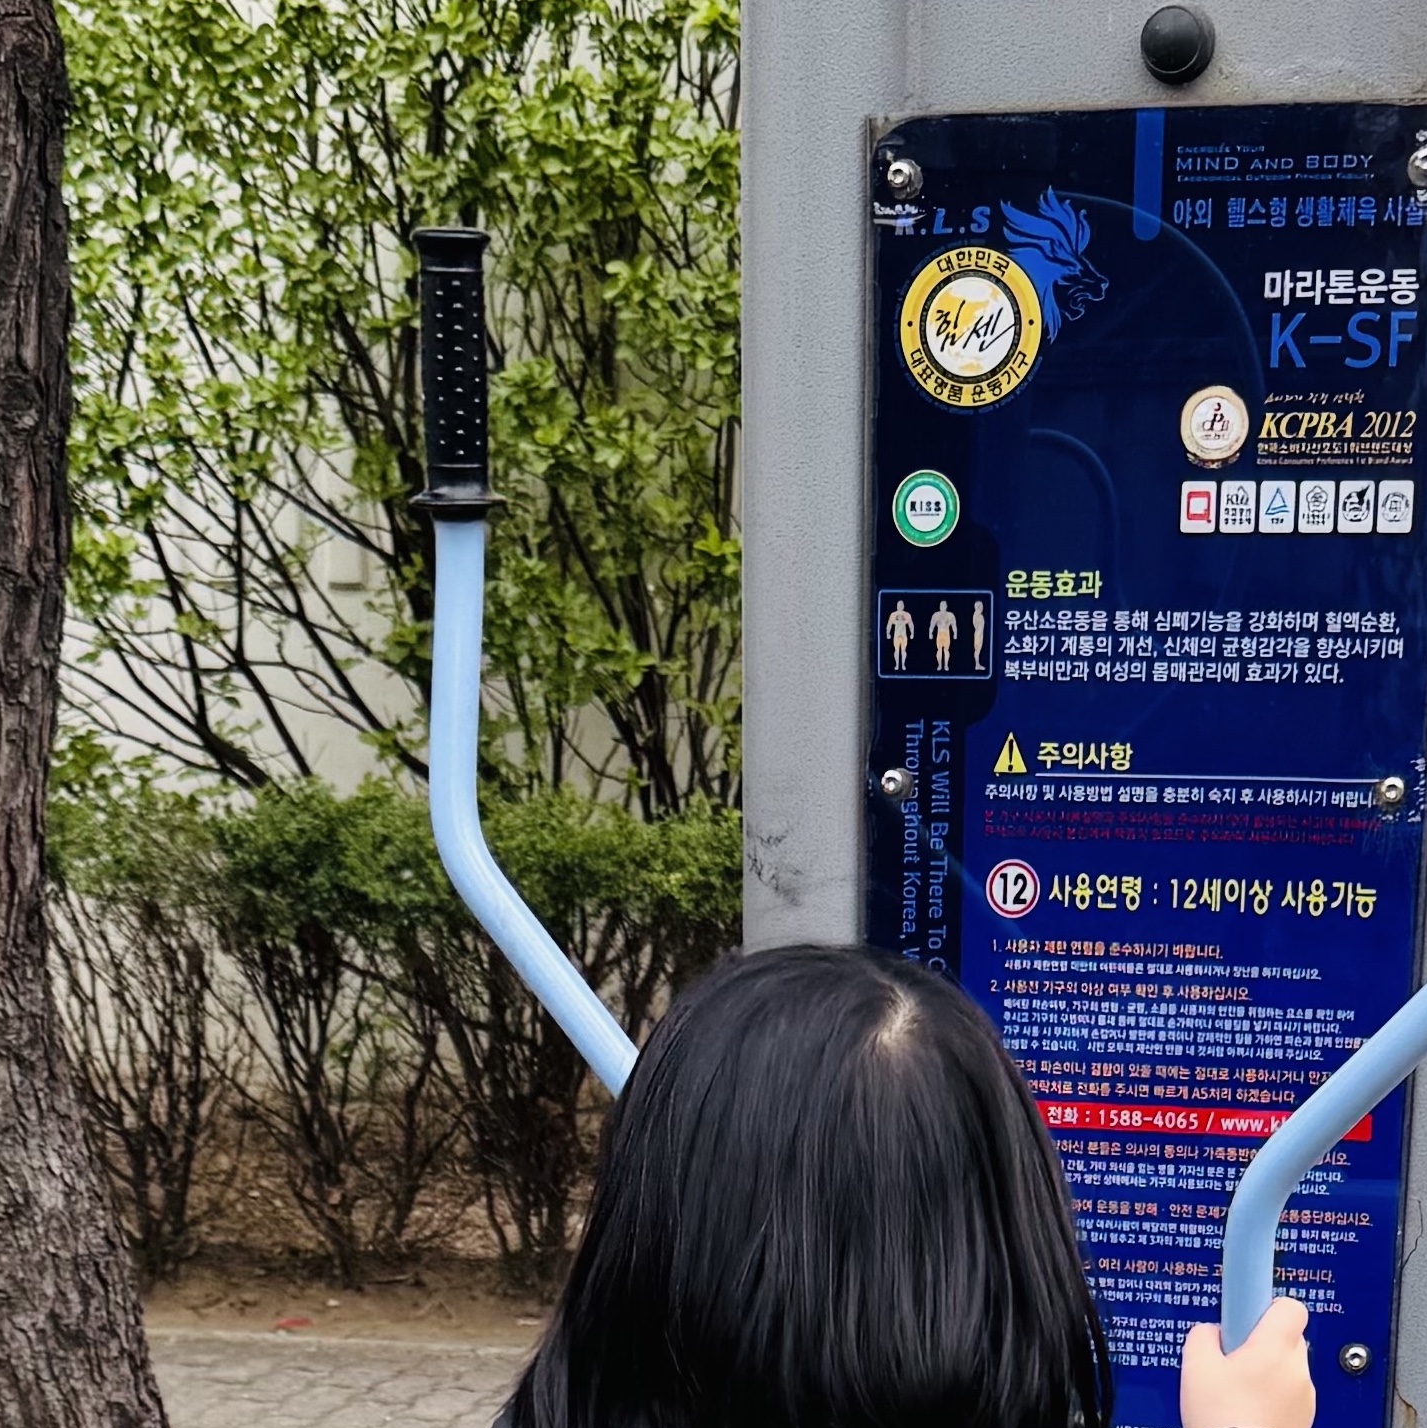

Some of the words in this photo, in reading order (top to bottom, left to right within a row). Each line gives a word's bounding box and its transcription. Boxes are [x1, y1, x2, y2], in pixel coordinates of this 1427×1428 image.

[1176, 156, 1239, 171] MIND
[1250, 158, 1294, 170] AND
[1305, 154, 1373, 169] BODY
[1173, 198, 1212, 229] 야외
[1295, 196, 1377, 228] 생활체육
[1383, 195, 1424, 227] 시설
[936, 249, 1011, 277] 대한민국
[1263, 268, 1420, 307] 마라톤운동
[934, 299, 1016, 353] 힘센
[1269, 311, 1418, 369] K-SF
[909, 347, 964, 404] 대표명품
[970, 349, 1030, 404] 운동기구
[1258, 411, 1354, 439] KCPBA
[1360, 410, 1417, 439] 2012
[1005, 569, 1103, 599] 운동효과
[1004, 609, 1108, 632] 유산소운동을
[1113, 610, 1149, 632] 통해
[1153, 610, 1244, 632] 심폐기능을
[1248, 610, 1319, 632] 강화하며
[1325, 611, 1401, 635] 혈액순환,
[1004, 635, 1055, 656] 소화기
[1060, 635, 1112, 656] 계통의
[1118, 635, 1158, 658] 개선,
[1163, 636, 1216, 657] 신체의
[1222, 636, 1311, 658] 균형감각을
[1316, 636, 1404, 659] 향상시키며
[1004, 660, 1089, 681] 복부비만과
[1095, 661, 1147, 682] 여성의
[1152, 661, 1240, 683] 몸매관리에
[1245, 662, 1298, 683] 효과가
[1304, 663, 1344, 684] 있다.
[931, 720, 951, 764] KLS
[1037, 741, 1134, 771] 주의사항
[931, 770, 950, 814] Will
[984, 783, 1039, 801] 주의사항
[1042, 784, 1055, 801] 및
[1058, 784, 1113, 802] 사용방법
[1117, 785, 1159, 803] 설명을
[1162, 786, 1204, 804] 충분히
[1207, 787, 1236, 804] 숙지
[1239, 787, 1254, 804] 후
[1258, 788, 1327, 807] 사용하시기
[929, 821, 949, 850] Be
[928, 855, 949, 919] There
[998, 872, 1028, 906] 12
[1048, 873, 1143, 912] 사용연령
[1152, 883, 1159, 905] :
[1170, 877, 1273, 915] 12세이상
[1280, 879, 1377, 919] 사용가능
[899, 871, 921, 939] Korea,
[927, 924, 947, 949] To
[1004, 939, 1041, 954] 사용자
[1108, 942, 1169, 958] 준수하시기
[1047, 1106, 1079, 1124] 전화
[1098, 1109, 1199, 1130] 1588-4065
[1320, 1151, 1351, 1166] 시오.
[1169, 1203, 1193, 1218] 안전
